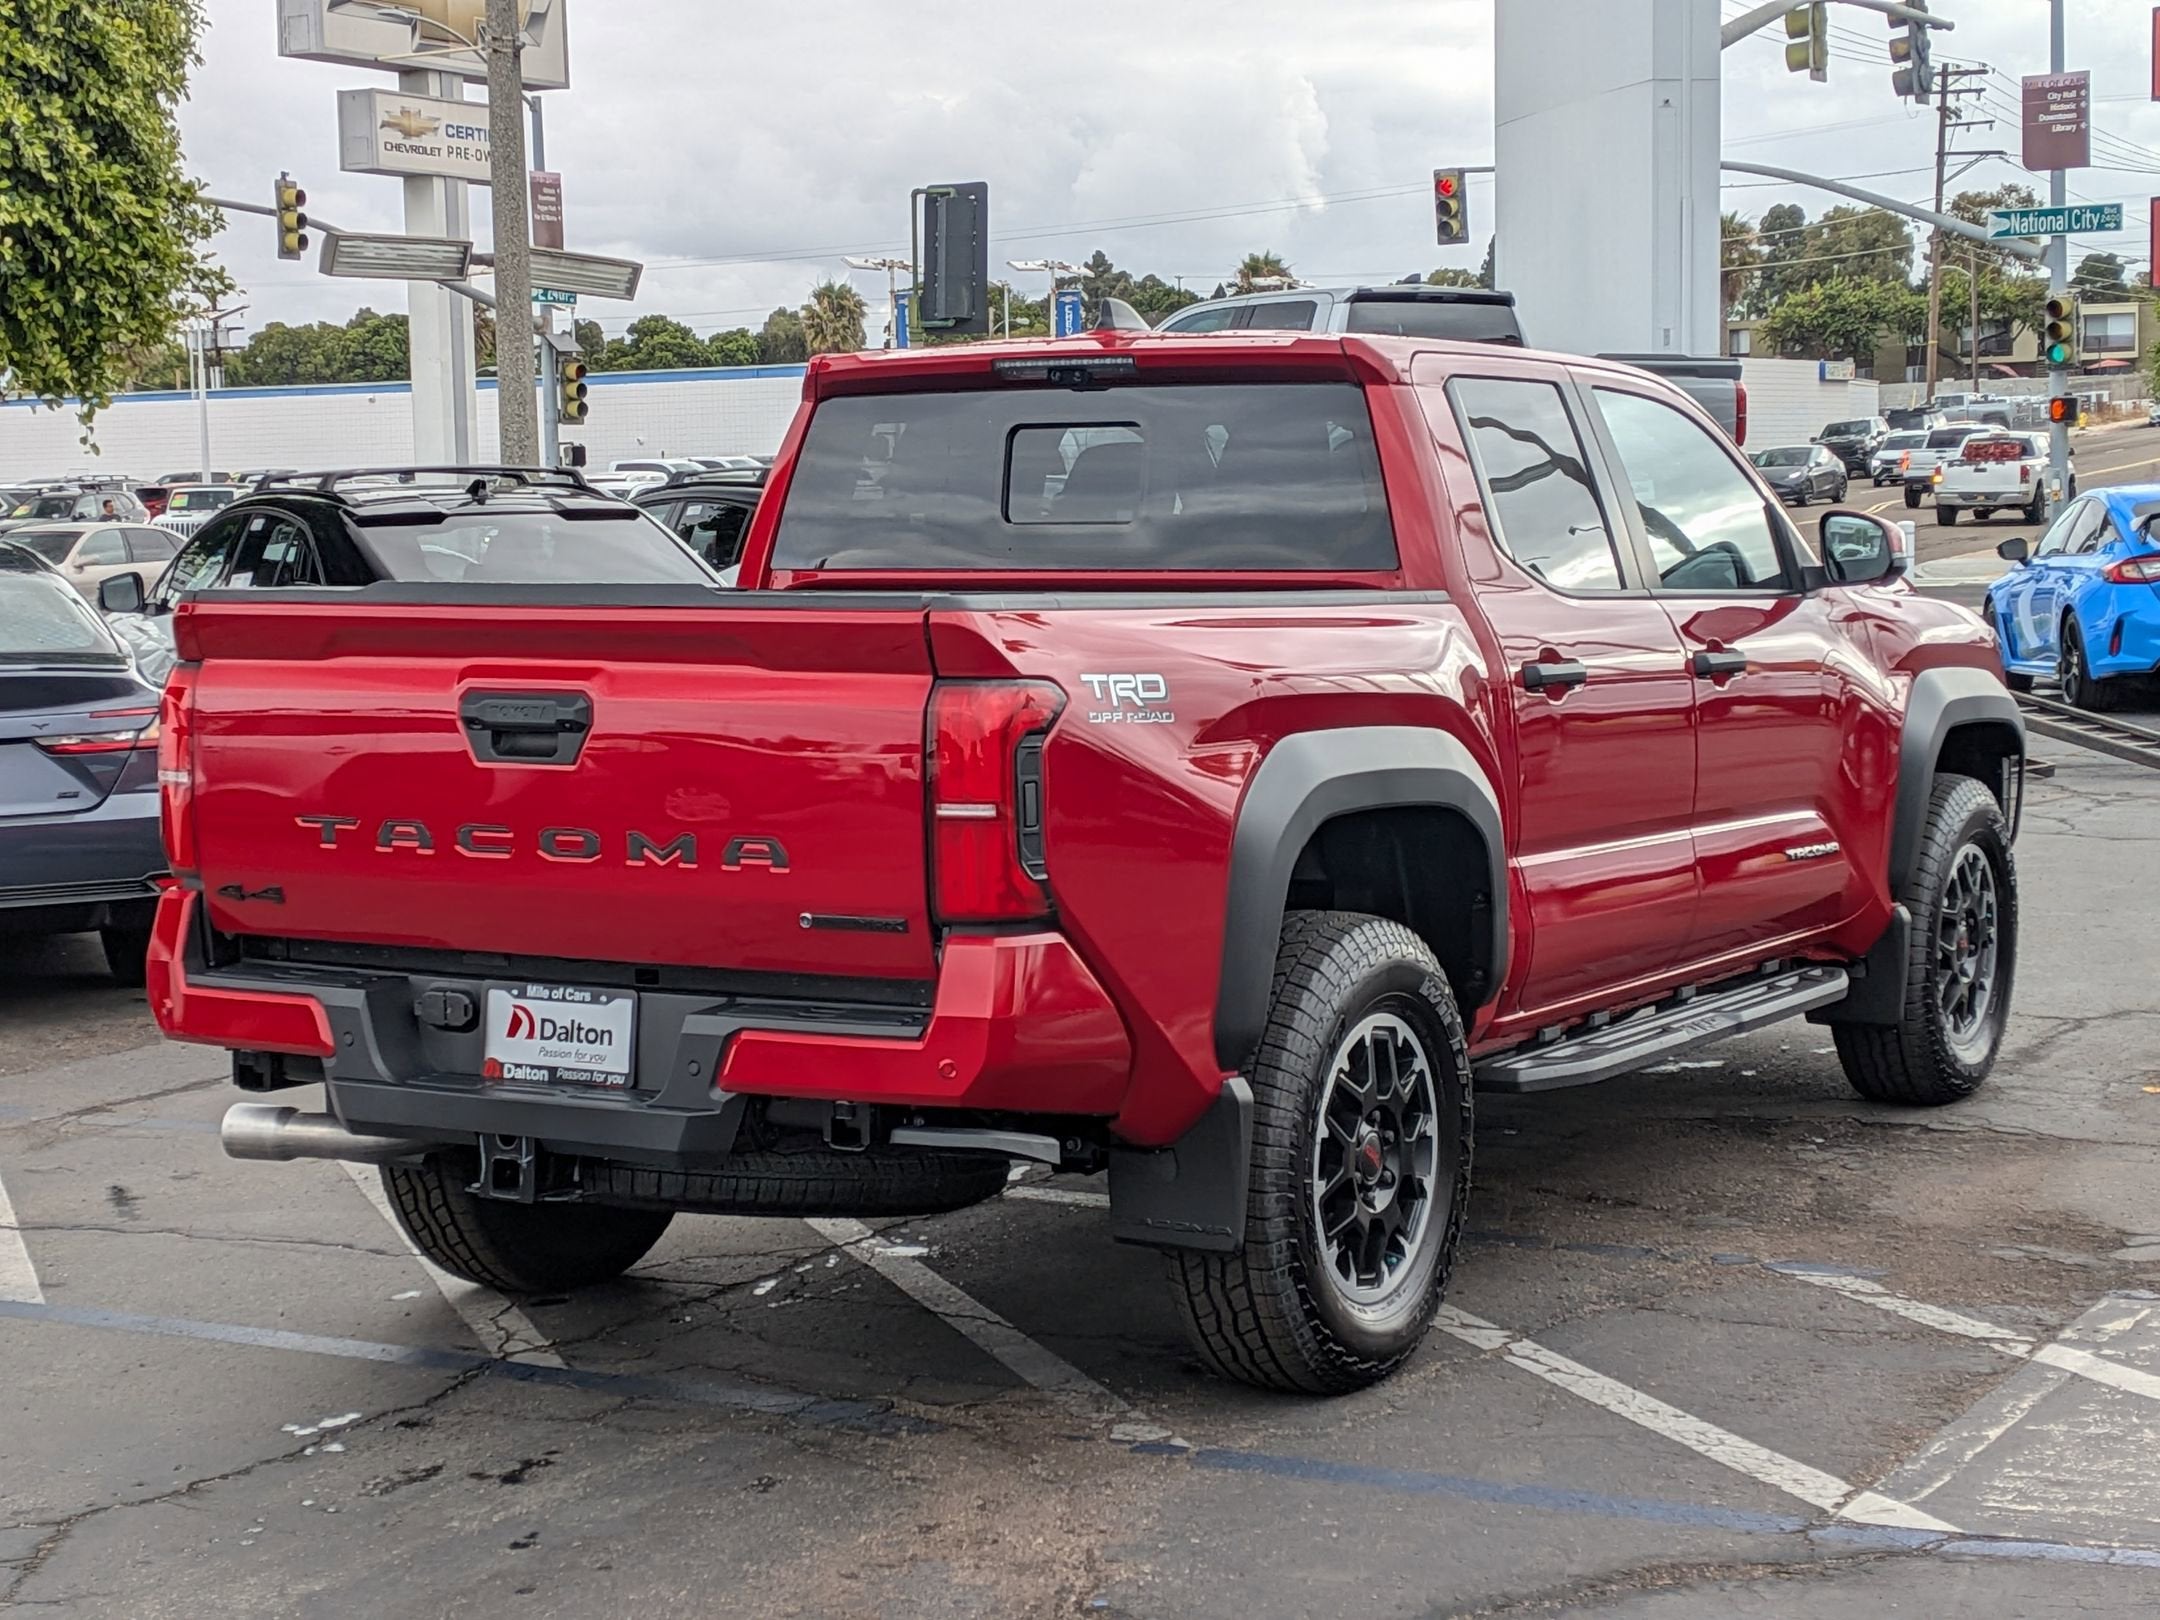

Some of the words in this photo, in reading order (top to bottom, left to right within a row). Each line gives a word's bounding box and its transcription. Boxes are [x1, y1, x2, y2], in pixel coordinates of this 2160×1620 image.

[2047, 92, 2062, 101] City
[2063, 90, 2077, 98] Hall
[445, 123, 491, 143] CERTI
[2052, 124, 2077, 132] Library
[383, 141, 442, 157] CHEVROLET
[2010, 211, 2069, 235] National
[2071, 208, 2101, 231] City
[1079, 673, 1167, 707] TRD
[1088, 711, 1123, 723] OFF
[1125, 711, 1175, 723] ROAD
[294, 813, 793, 875] TACOMA
[526, 984, 549, 999] Mile
[551, 986, 565, 1001] of
[565, 987, 592, 1002] Cars
[539, 1017, 613, 1047] Dalton
[538, 1046, 573, 1060] Passion
[573, 1048, 589, 1062] for
[588, 1052, 607, 1063] you
[503, 1064, 549, 1082] Dalton
[556, 1067, 592, 1081] Passion
[591, 1070, 606, 1084] for
[605, 1073, 626, 1086] you
